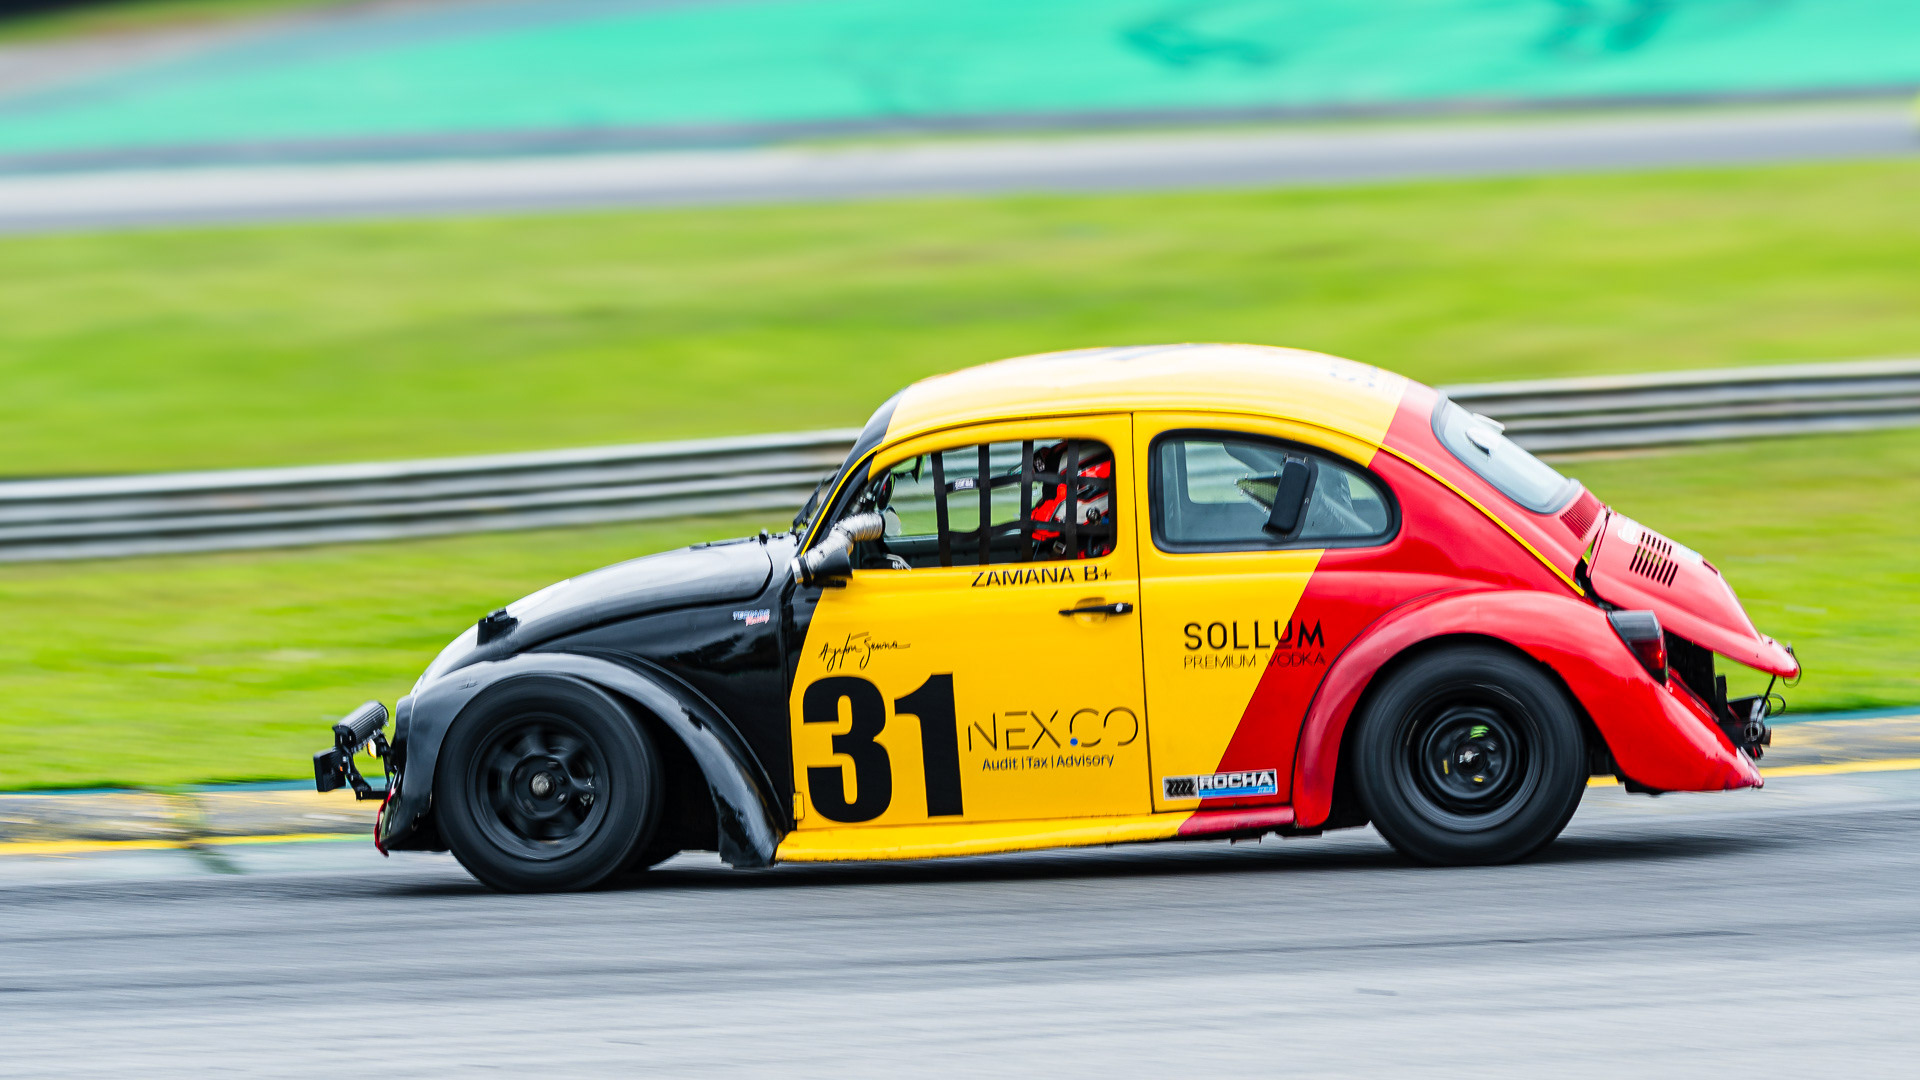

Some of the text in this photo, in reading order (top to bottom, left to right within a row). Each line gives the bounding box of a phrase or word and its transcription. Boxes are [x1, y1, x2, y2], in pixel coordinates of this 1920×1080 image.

[971, 565, 1112, 587] ZAMANA B+
[1183, 618, 1325, 651] SOLLUM
[1183, 651, 1326, 670] PREMIUM VODKA
[802, 671, 964, 824] 31
[1198, 770, 1274, 790] ROCHA
